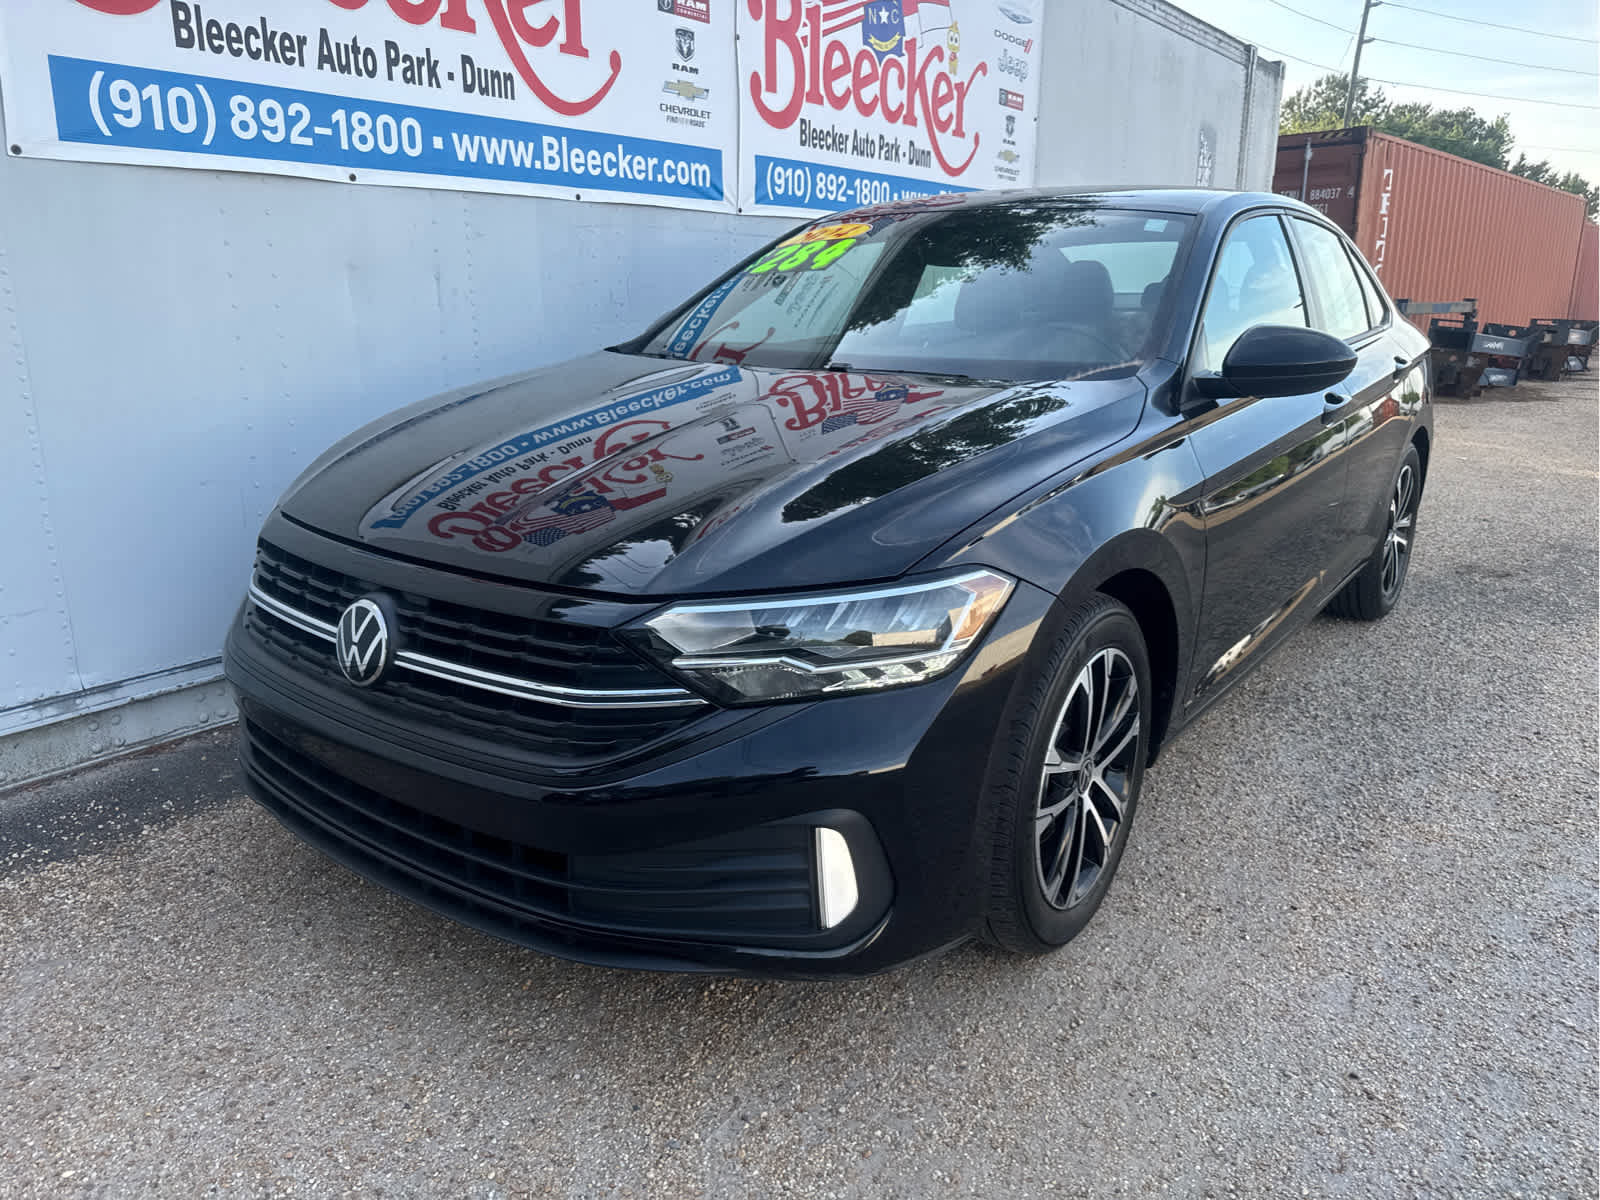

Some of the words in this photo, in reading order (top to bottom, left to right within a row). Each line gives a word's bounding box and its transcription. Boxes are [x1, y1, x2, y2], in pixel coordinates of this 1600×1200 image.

[171, 0, 307, 67] Bleecker
[316, 28, 378, 79] Auto
[385, 40, 441, 89] Park
[461, 54, 516, 101] Dunn
[994, 29, 1028, 48] DODGE
[672, 62, 699, 75] RAM
[747, 0, 988, 177] Bleecker
[89, 70, 217, 146] (910)
[229, 94, 423, 157] 892-1800
[451, 131, 711, 188] www.Bleecker.com
[659, 103, 712, 120] CHEVROLET
[800, 118, 849, 154] Bleecker
[851, 129, 876, 160] Auto
[878, 134, 900, 163] Park
[908, 140, 932, 168] Dunn
[766, 161, 812, 204] (910)
[815, 172, 890, 206] 892-1800
